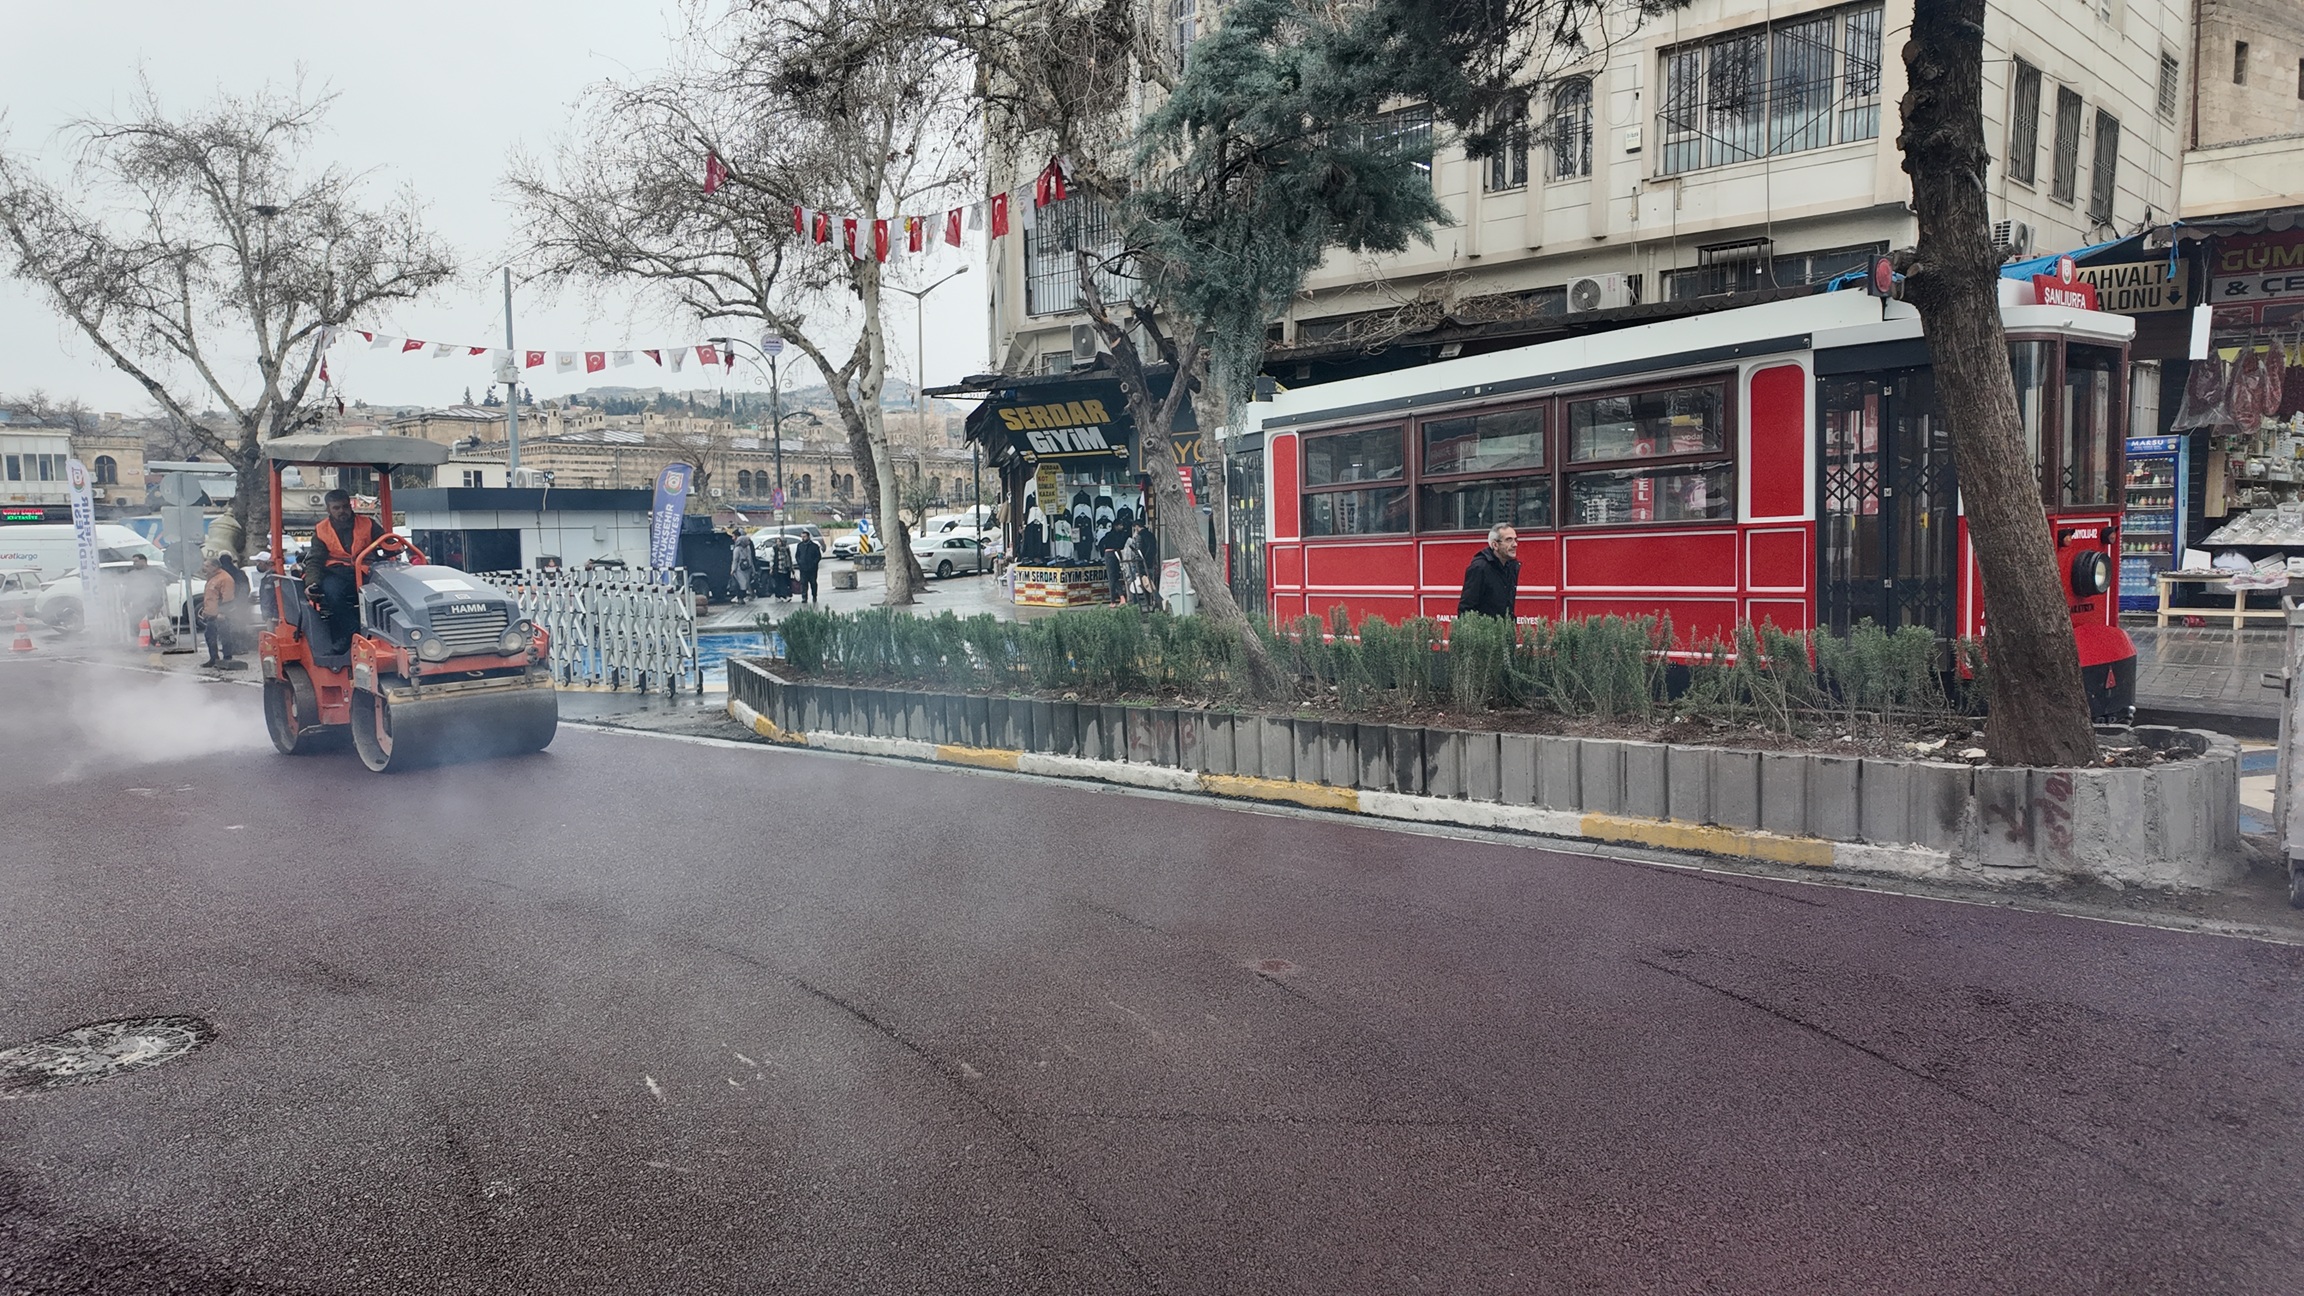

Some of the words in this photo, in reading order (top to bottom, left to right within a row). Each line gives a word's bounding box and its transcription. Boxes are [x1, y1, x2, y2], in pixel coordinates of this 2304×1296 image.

[2044, 286, 2087, 310] ŞANLIURFA
[2097, 286, 2162, 312] ALONU
[998, 400, 1111, 431] SERDAR
[2131, 439, 2164, 447] MARSU
[0, 552, 38, 561] uratkargo
[1032, 571, 1058, 583] SERDAR
[1084, 569, 1110, 582] SERDA
[451, 603, 487, 614] HAMM
